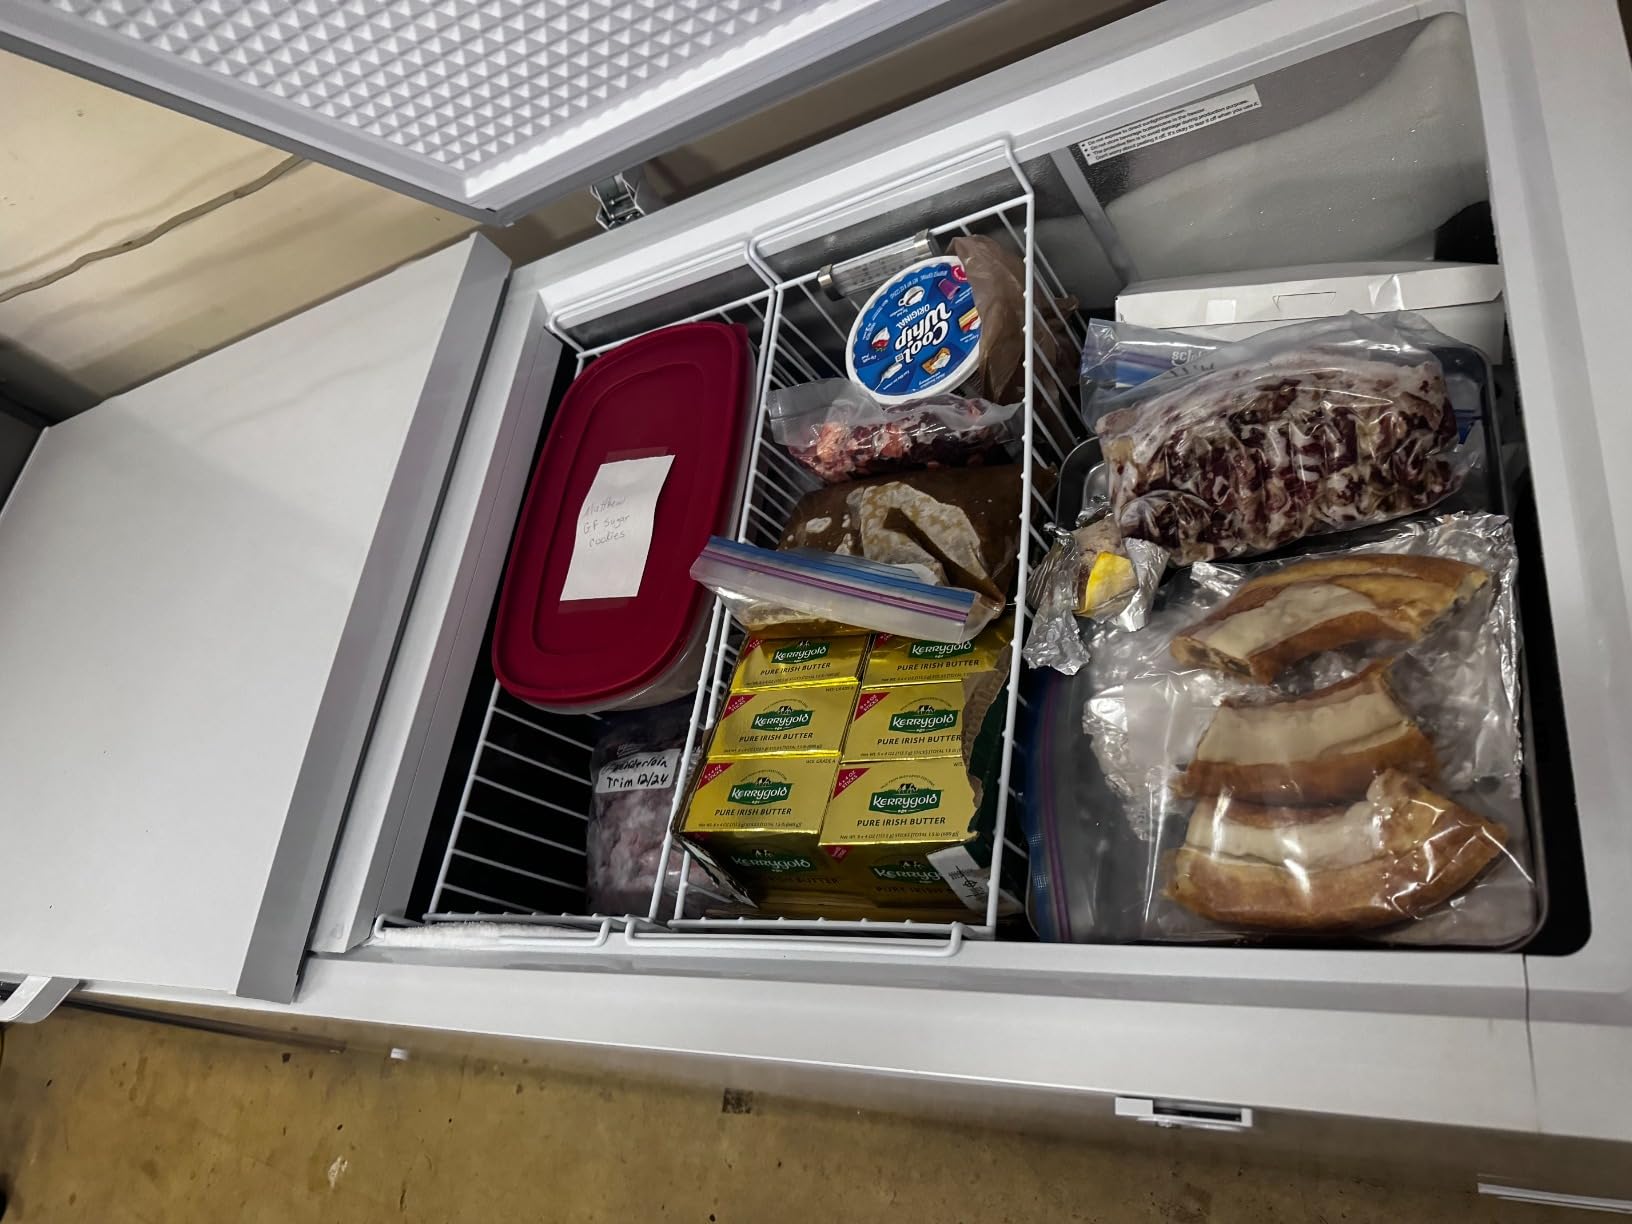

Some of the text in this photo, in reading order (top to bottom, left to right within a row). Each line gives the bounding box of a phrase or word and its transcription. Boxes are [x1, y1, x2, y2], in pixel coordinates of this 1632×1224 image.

[896, 304, 930, 329] ORIGINAL
[895, 302, 952, 350] Whip
[903, 320, 949, 363] Cool
[775, 645, 828, 660] Kerrygold
[911, 640, 972, 656] Kerrygold
[760, 662, 831, 676] PURE IRISH BUTTER
[896, 659, 980, 672] PURE IRISH BUTTER
[754, 713, 809, 727] Kerrygold
[892, 713, 954, 728] Kerrygold
[738, 732, 814, 743] PURE IRISH BUTTER
[901, 736, 926, 745] IRISH
[927, 734, 962, 743] BUTTER
[607, 772, 669, 788] Trim 12/24
[731, 787, 788, 800] Kerrygold
[872, 793, 938, 809] Kerrygold
[736, 808, 759, 816] IRISH
[856, 816, 946, 827] PURE IRISH BUTTER
[730, 855, 811, 869] Kerrygold
[873, 868, 941, 880] Kerryg
